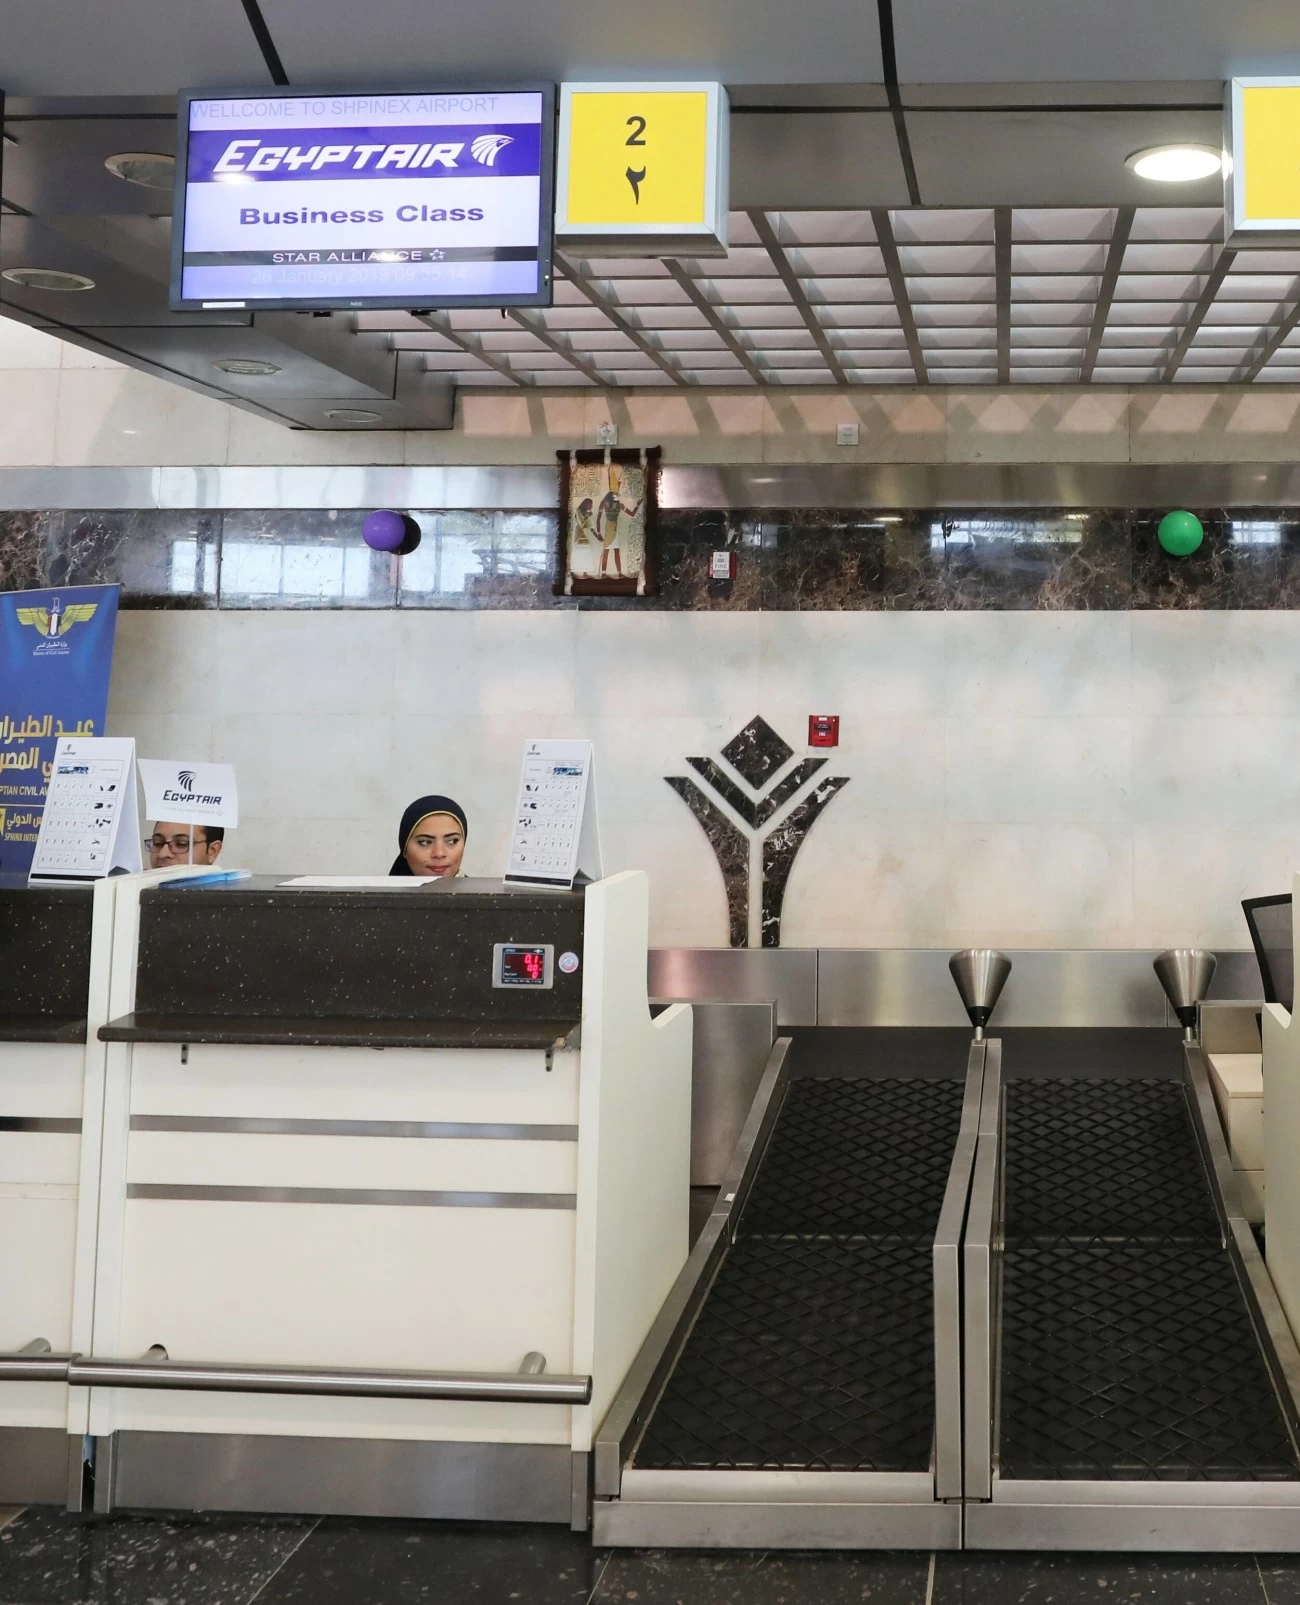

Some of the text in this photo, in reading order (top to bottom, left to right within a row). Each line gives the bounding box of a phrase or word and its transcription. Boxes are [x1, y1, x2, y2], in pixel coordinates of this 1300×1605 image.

[190, 96, 499, 120] WELLCOME TO SHPINEX AIRPORT
[625, 116, 647, 147] 2
[212, 139, 466, 173] EGYPTAIR
[239, 205, 485, 225] Business Class
[272, 251, 422, 263] STAR ALLIACE
[0, 785, 18, 795] PTIAN
[19, 785, 38, 796] CIVIL
[163, 789, 222, 805] EGYPTAIR
